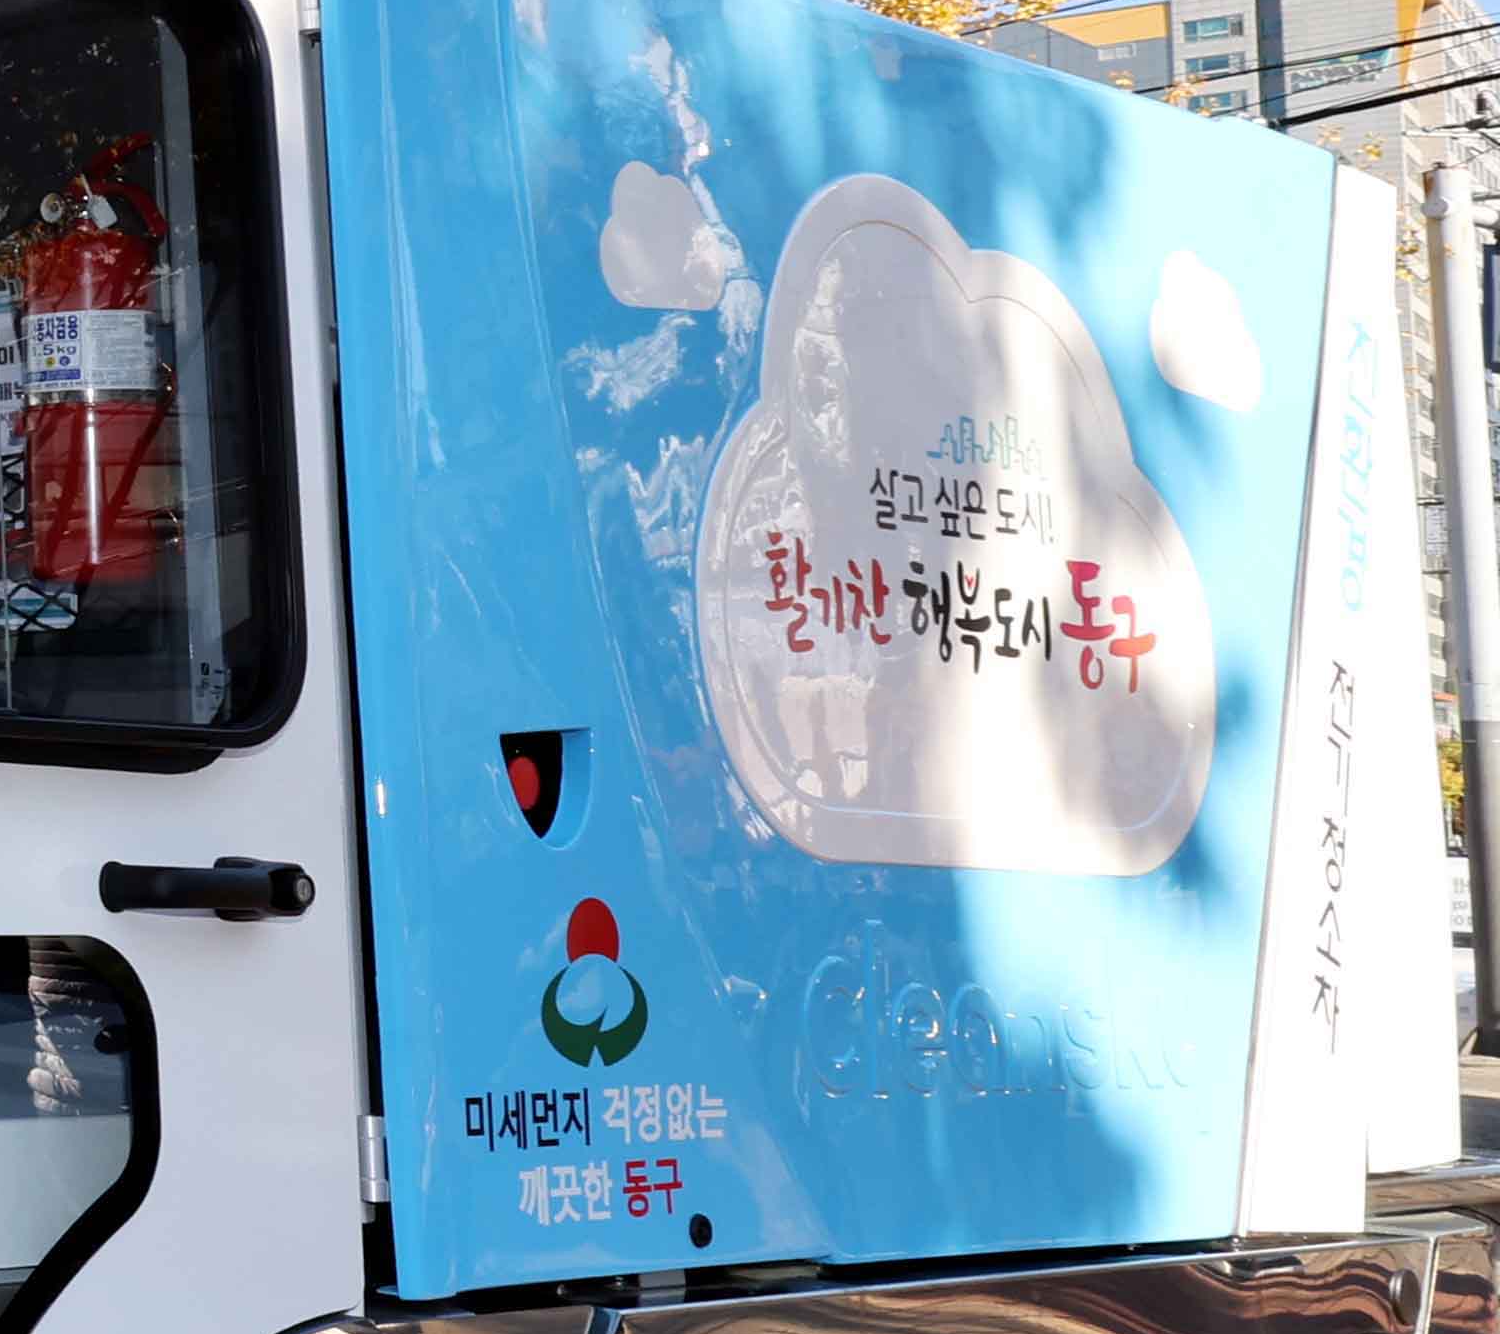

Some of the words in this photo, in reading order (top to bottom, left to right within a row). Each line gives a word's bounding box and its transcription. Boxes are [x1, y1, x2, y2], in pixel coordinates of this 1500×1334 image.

[868, 466, 925, 532] 살고
[935, 472, 988, 544] 싶은
[994, 487, 1057, 546] 도시!
[764, 531, 892, 654] 활기찬
[901, 558, 1053, 674] 행복도시
[1059, 558, 1159, 694] 동구
[465, 1087, 592, 1152] 미세먼지
[601, 1082, 727, 1145] 걱정없는
[518, 1160, 613, 1227] 깨끗한
[621, 1157, 684, 1219] 동구
